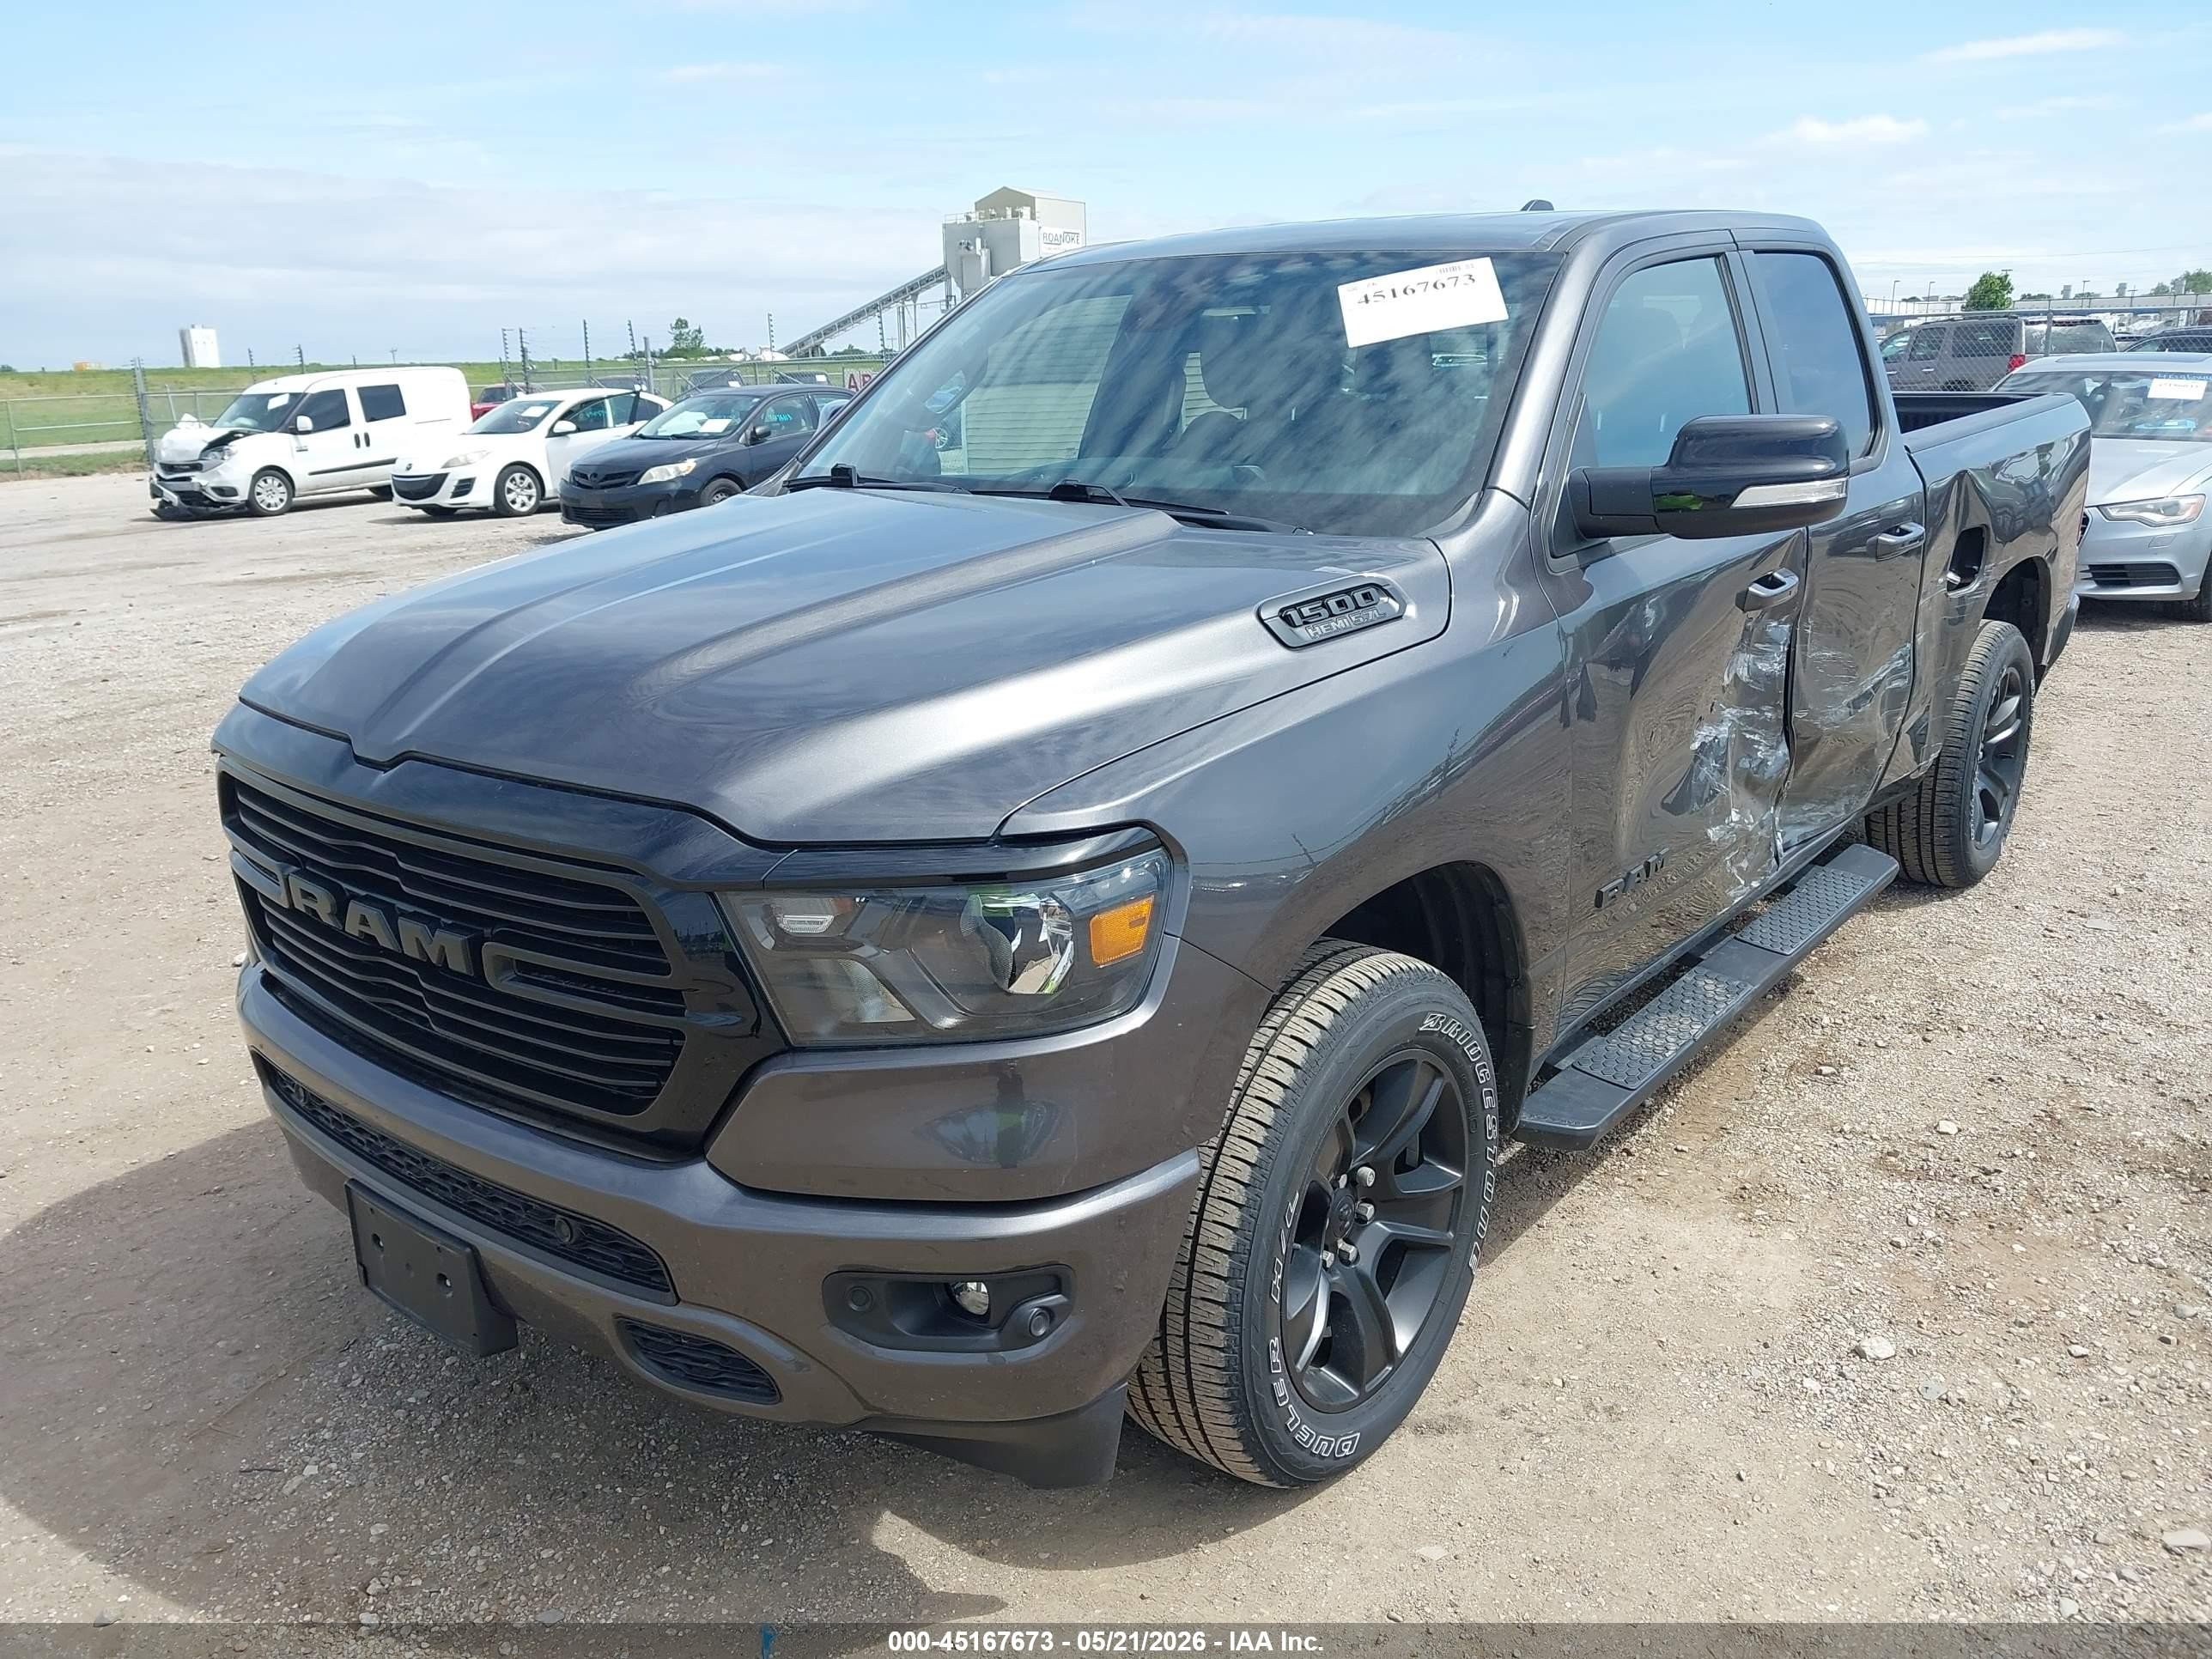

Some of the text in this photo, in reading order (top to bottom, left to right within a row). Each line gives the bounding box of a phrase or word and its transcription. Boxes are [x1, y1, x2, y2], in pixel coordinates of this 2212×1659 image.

[1042, 231, 1080, 245] ROANOKE
[1357, 274, 1476, 305] 45167673
[1282, 586, 1381, 628] 1500
[1306, 608, 1386, 639] HEMI 5.7L
[1595, 847, 1670, 908] RAM
[288, 869, 475, 977] RAM
[1419, 1012, 1498, 1276] BRIDGESTONE
[1269, 1336, 1361, 1458] DUELER
